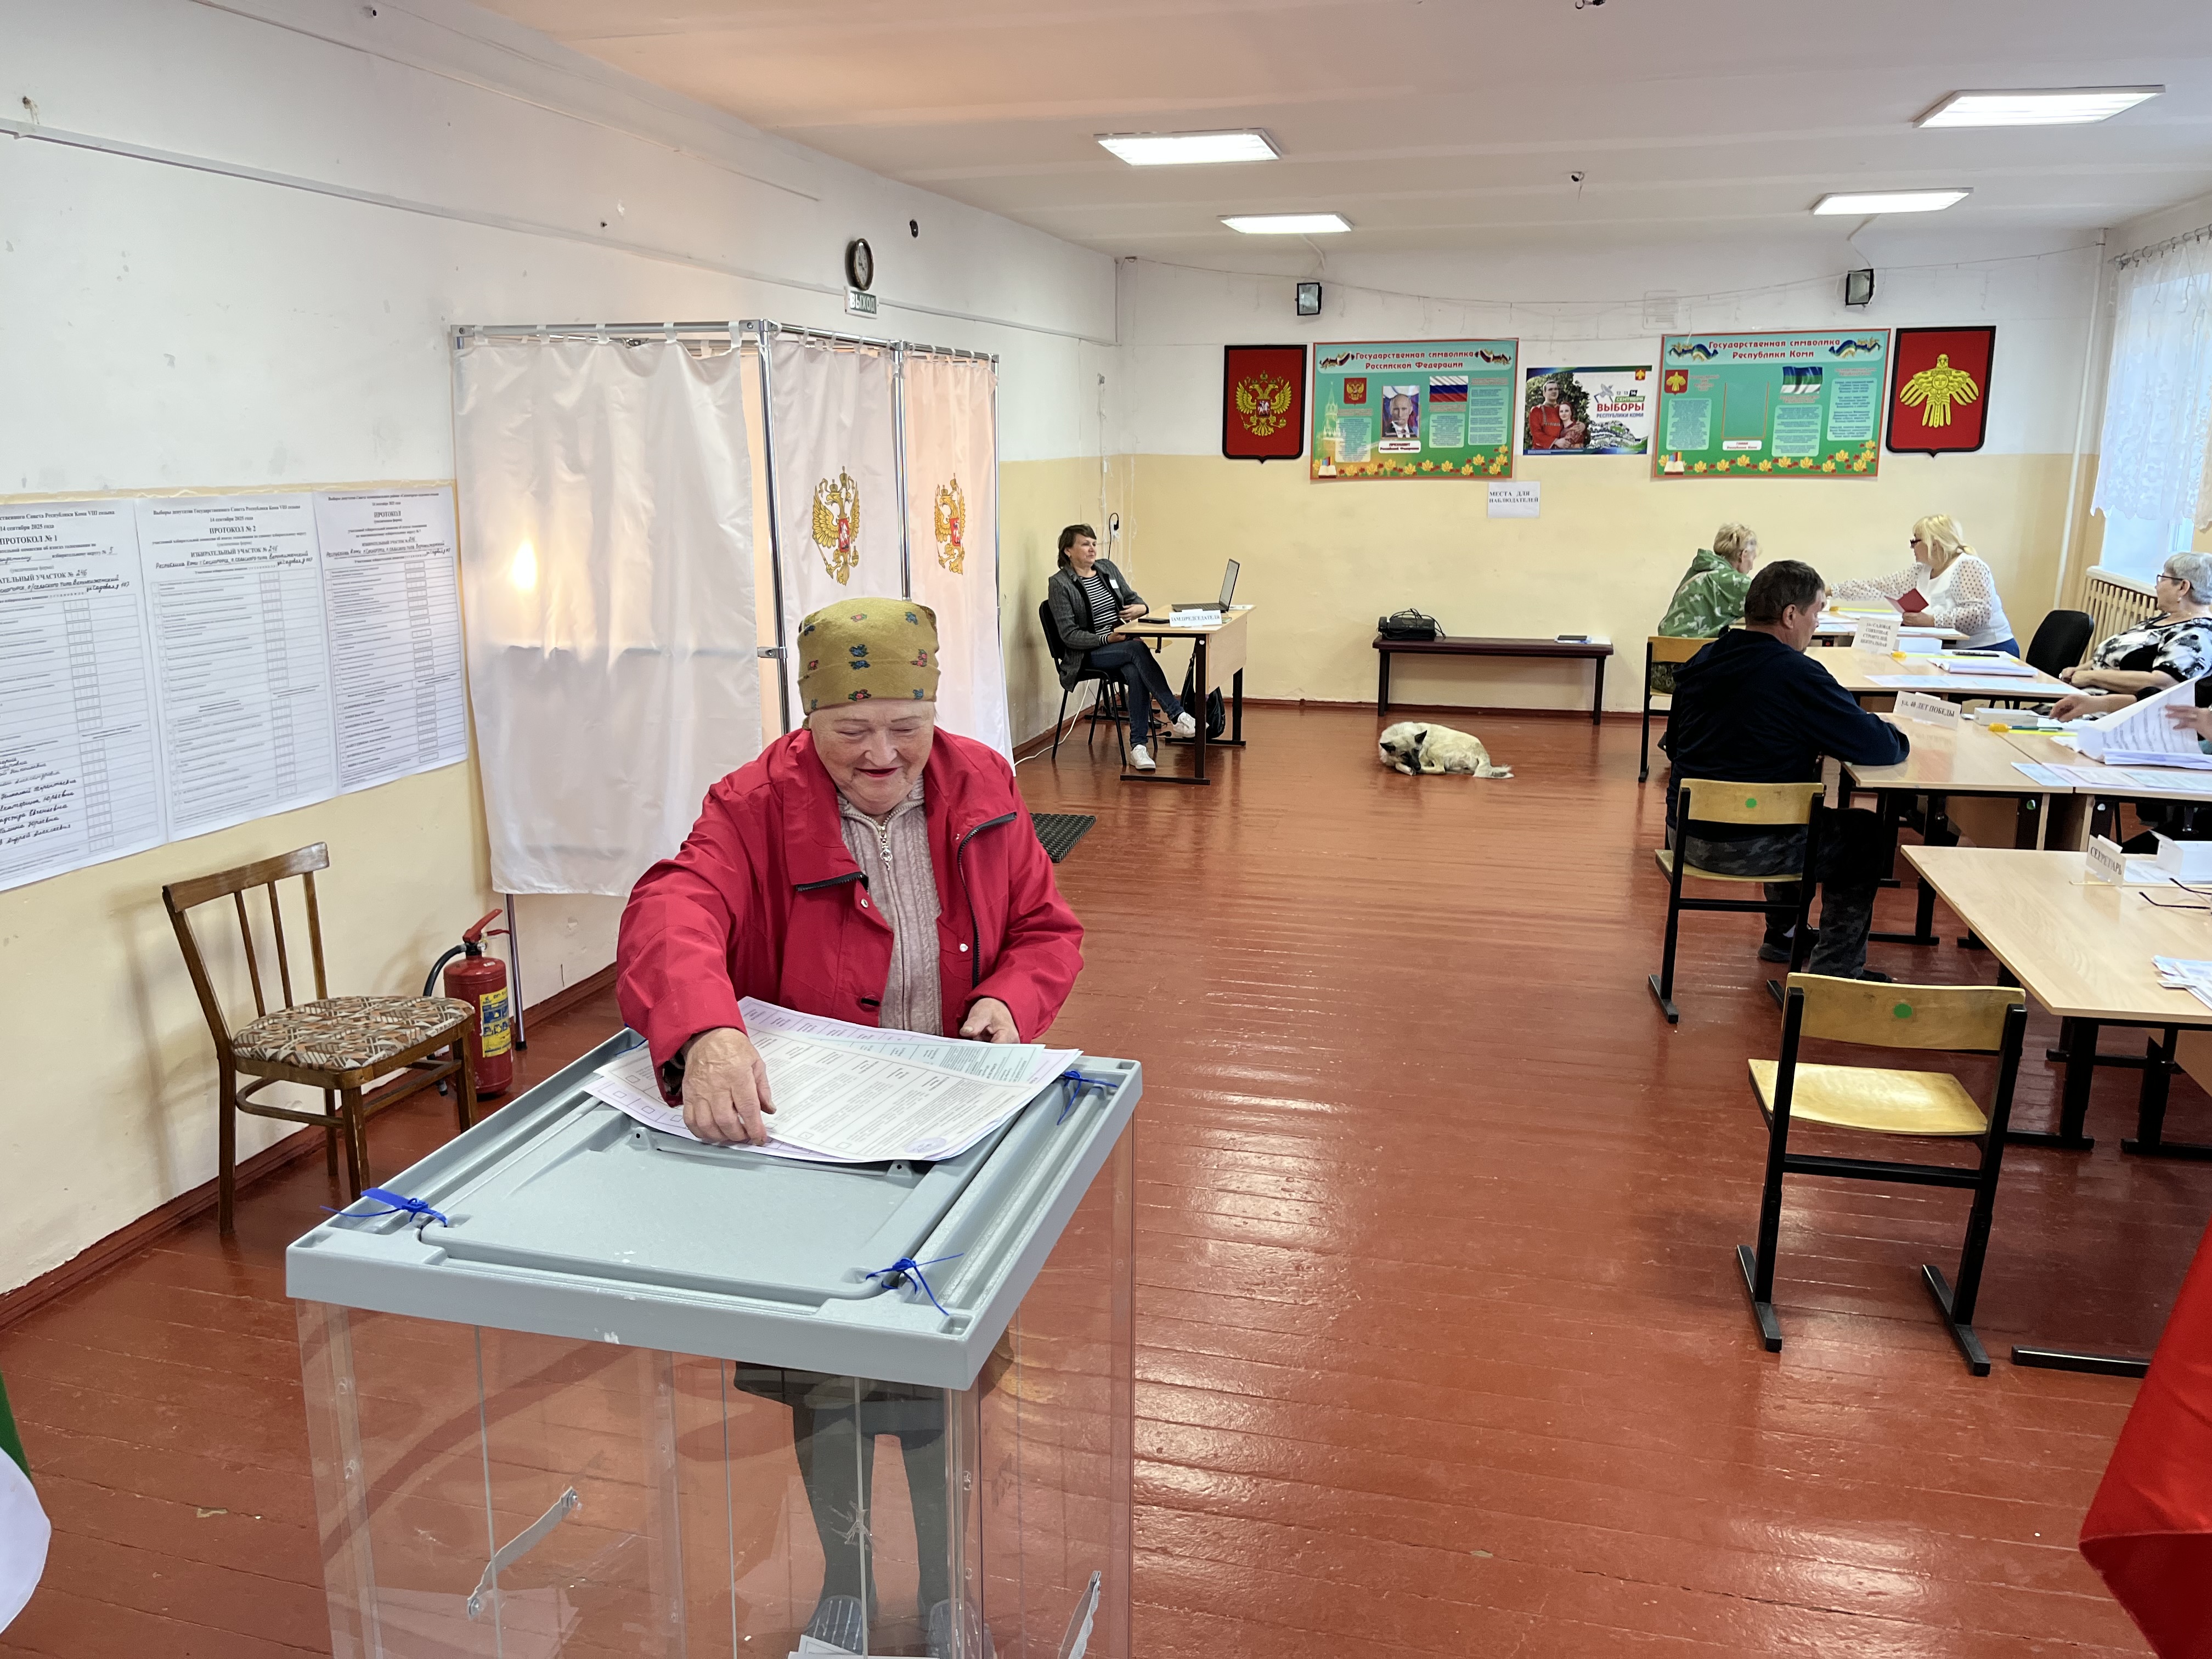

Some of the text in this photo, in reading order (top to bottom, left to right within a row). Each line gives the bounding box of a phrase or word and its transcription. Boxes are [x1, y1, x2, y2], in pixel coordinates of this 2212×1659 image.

[850, 292, 876, 312] ВЫХОД
[1709, 341, 1786, 350] Государственная
[1356, 352, 1425, 360] Государственная
[1733, 351, 1786, 360] Республики
[1365, 362, 1463, 370] Российской Федерации
[1597, 403, 1644, 411] ВЫБОРЫ
[0, 535, 43, 545] ПРОТОКОЛ
[44, 534, 53, 543] №
[36, 572, 66, 580] УЧАСТОК
[1916, 703, 1929, 711] ЛЕТ
[1929, 705, 1955, 717] ПОБЕДЫ
[2090, 847, 2122, 876] СЕКРЕТАРЬ
